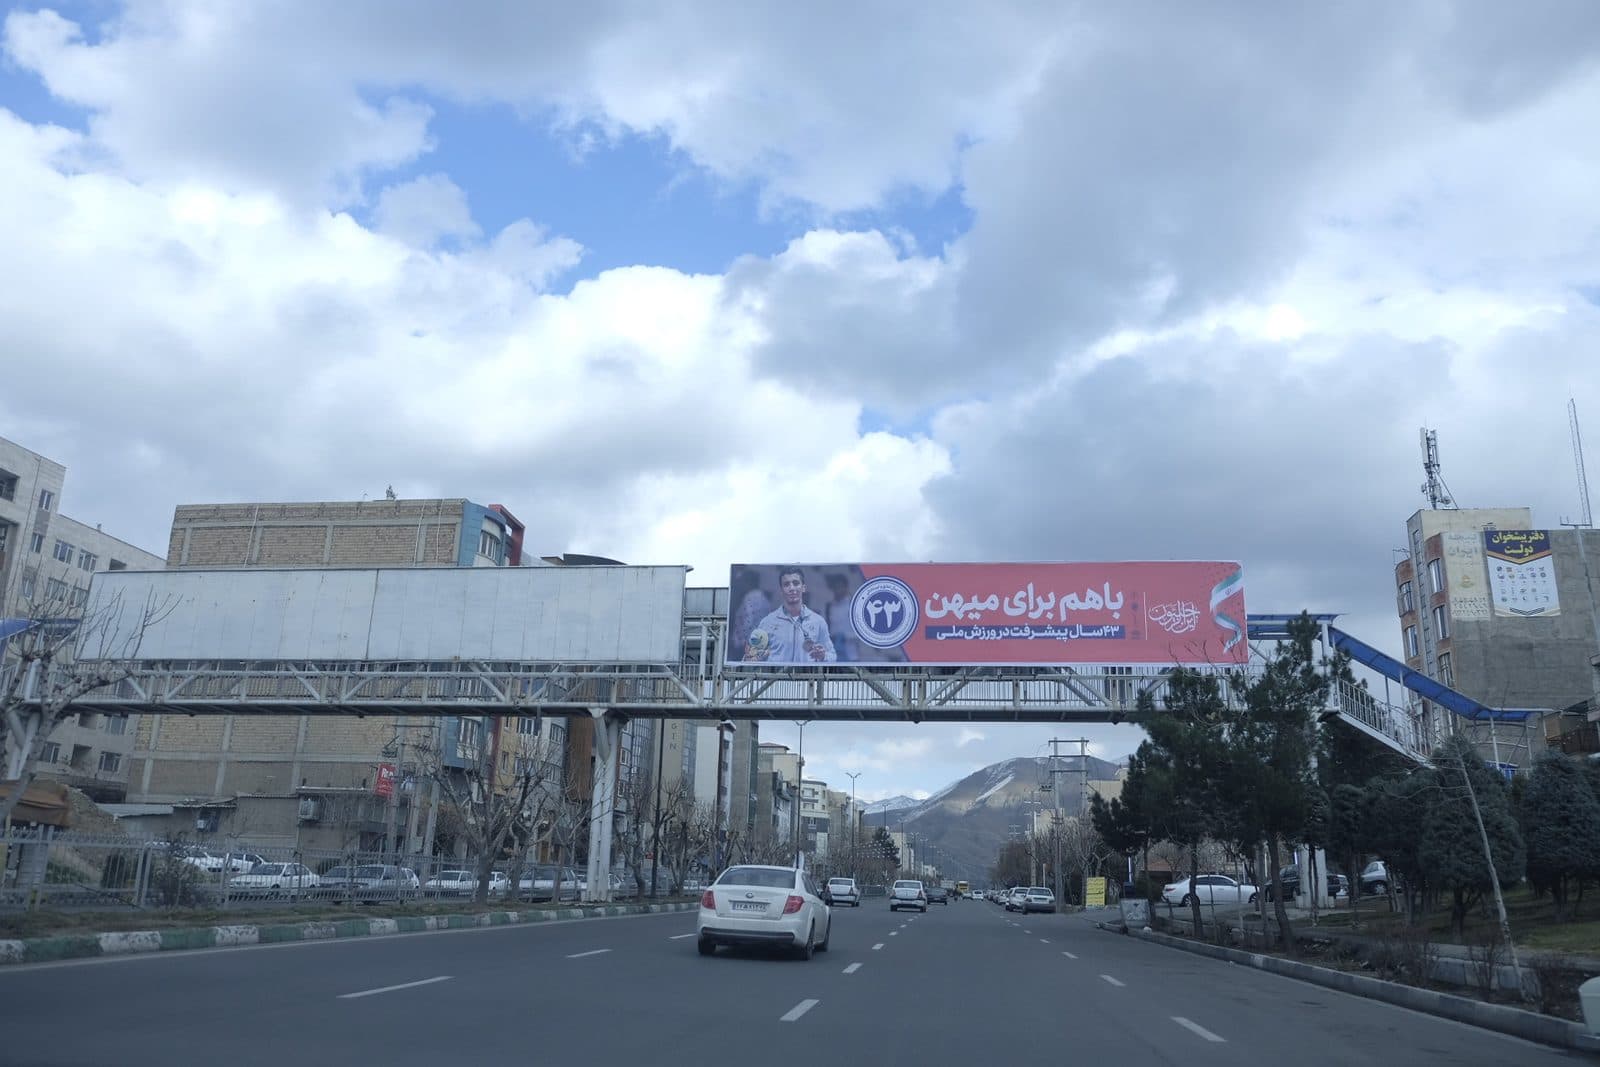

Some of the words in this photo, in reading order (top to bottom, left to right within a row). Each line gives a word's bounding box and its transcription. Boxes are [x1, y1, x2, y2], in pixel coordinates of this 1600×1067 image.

[1491, 531, 1527, 544] پیشخوان
[1528, 530, 1545, 543] دفتر
[1504, 544, 1534, 556] دولت
[925, 592, 999, 620] میهن
[1003, 582, 1056, 619] برای
[866, 599, 901, 629] ۴۳
[936, 625, 964, 640] ملی
[964, 624, 997, 640] ورزش
[998, 627, 1010, 640] در
[1010, 625, 1068, 642] پیشرفت
[1069, 624, 1102, 639] سال
